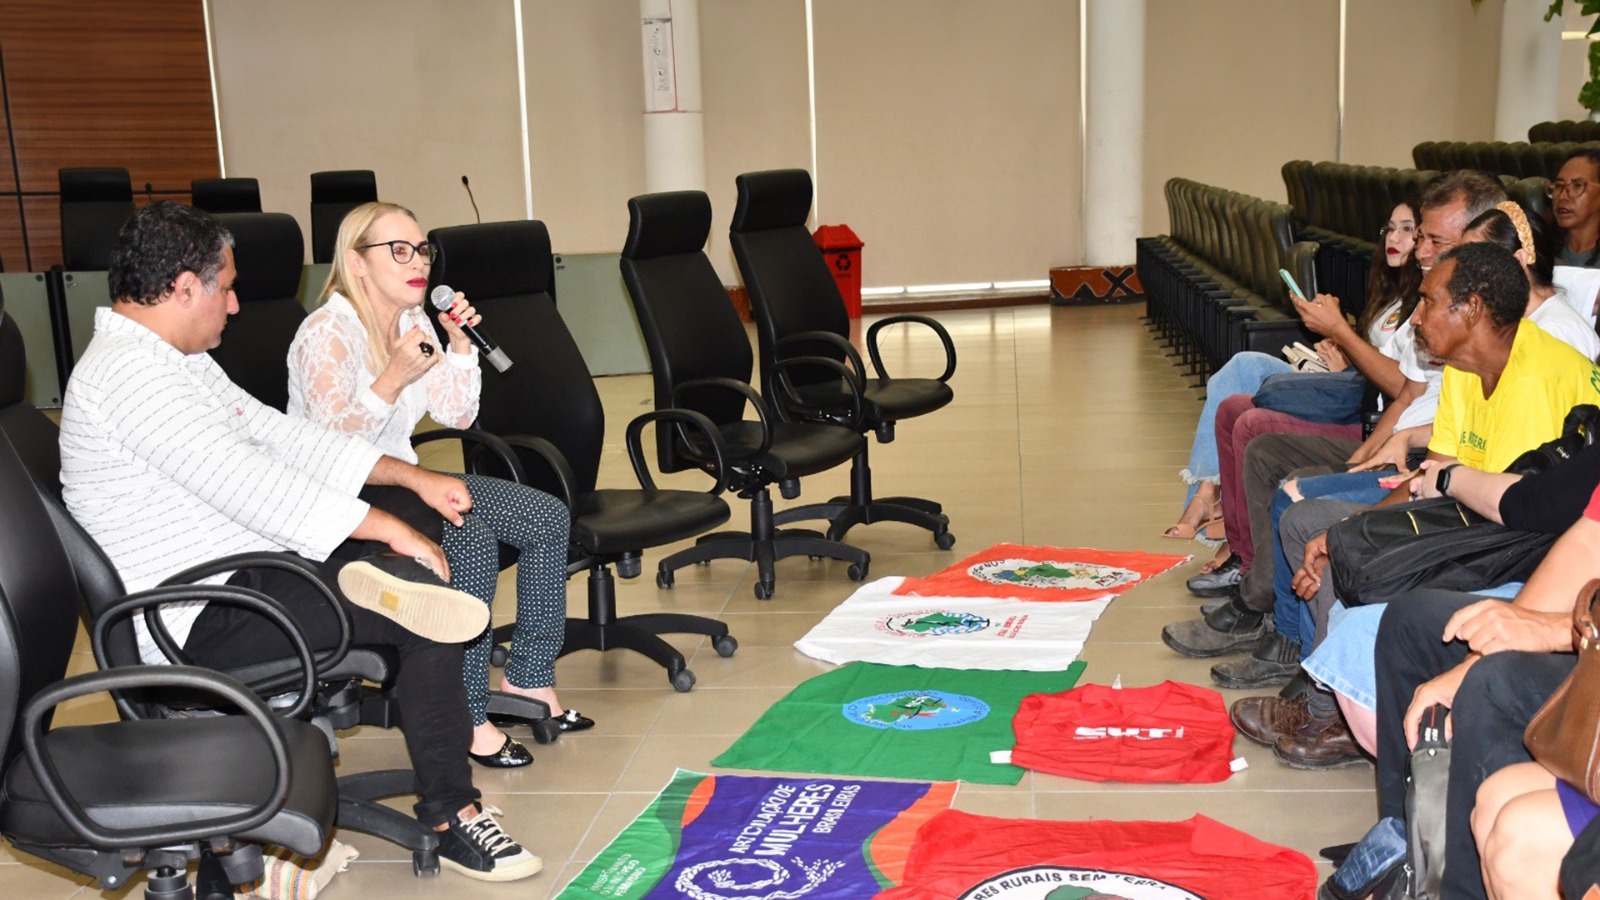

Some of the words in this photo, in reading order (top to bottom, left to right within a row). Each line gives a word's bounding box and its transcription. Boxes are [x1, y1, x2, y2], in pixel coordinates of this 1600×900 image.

[753, 783, 836, 856] MULHERES
[812, 784, 861, 834] BRASILEIRAS
[999, 872, 1063, 891] RURAIS
[1068, 873, 1107, 882] SEM
[1114, 874, 1167, 890] ERRA
